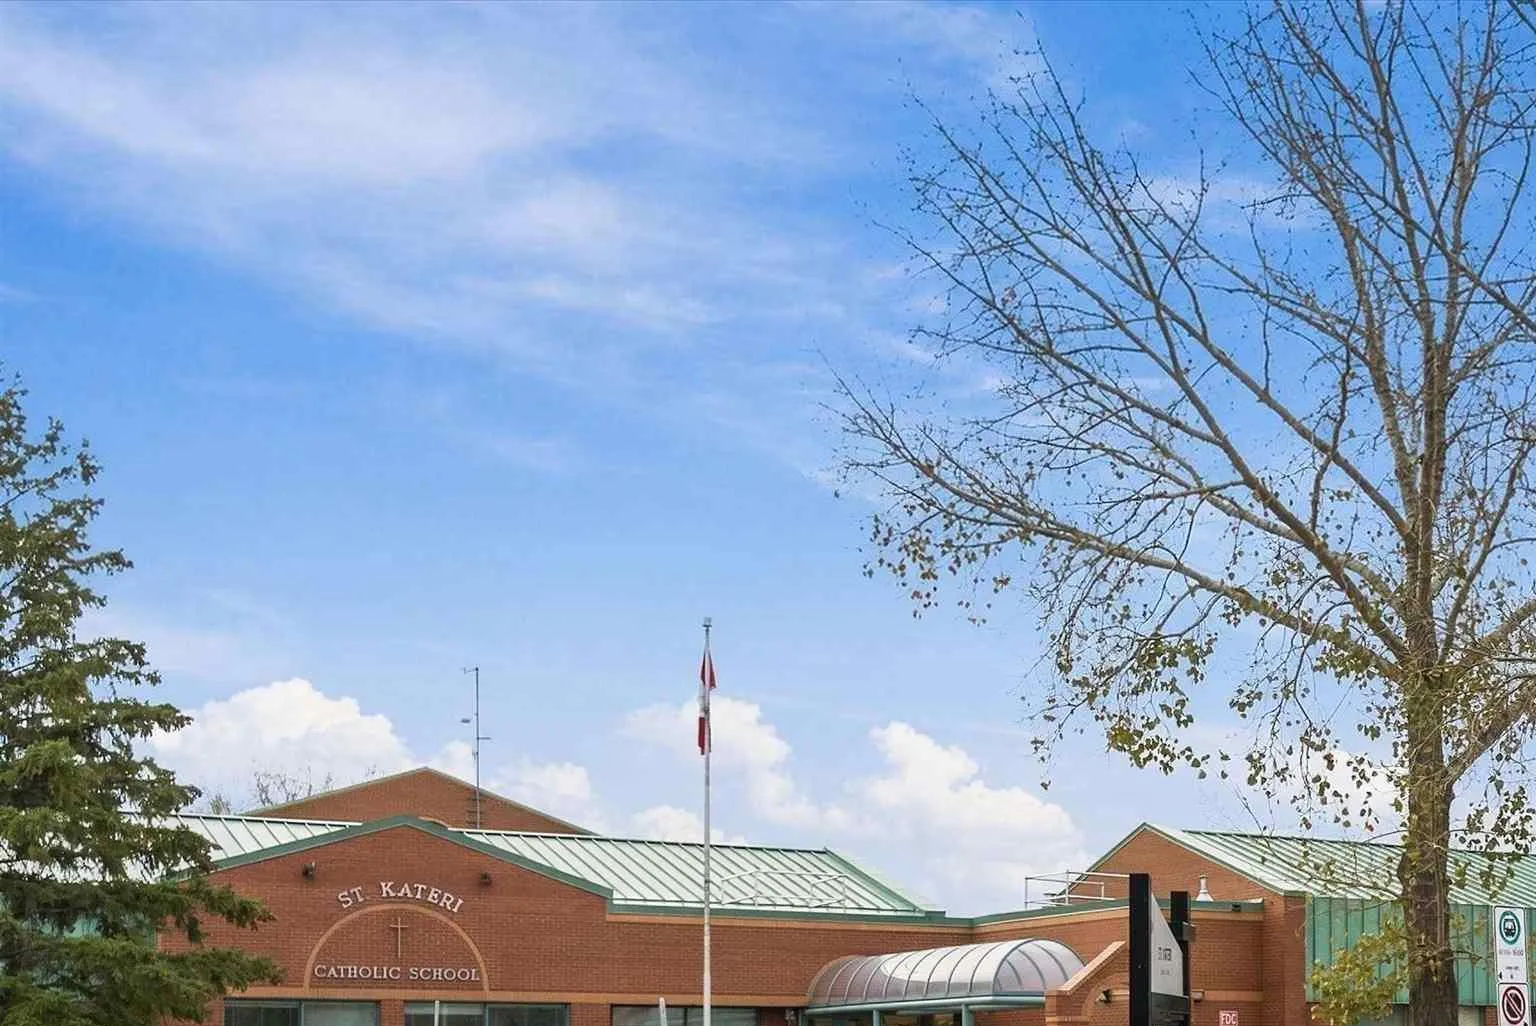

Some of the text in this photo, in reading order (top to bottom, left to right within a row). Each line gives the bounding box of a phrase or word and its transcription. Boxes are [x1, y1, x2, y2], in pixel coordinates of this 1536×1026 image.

[380, 881, 464, 913] KATERI
[315, 965, 480, 982] CATHOLIC SCHOOL
[1221, 1013, 1238, 1025] FDC
